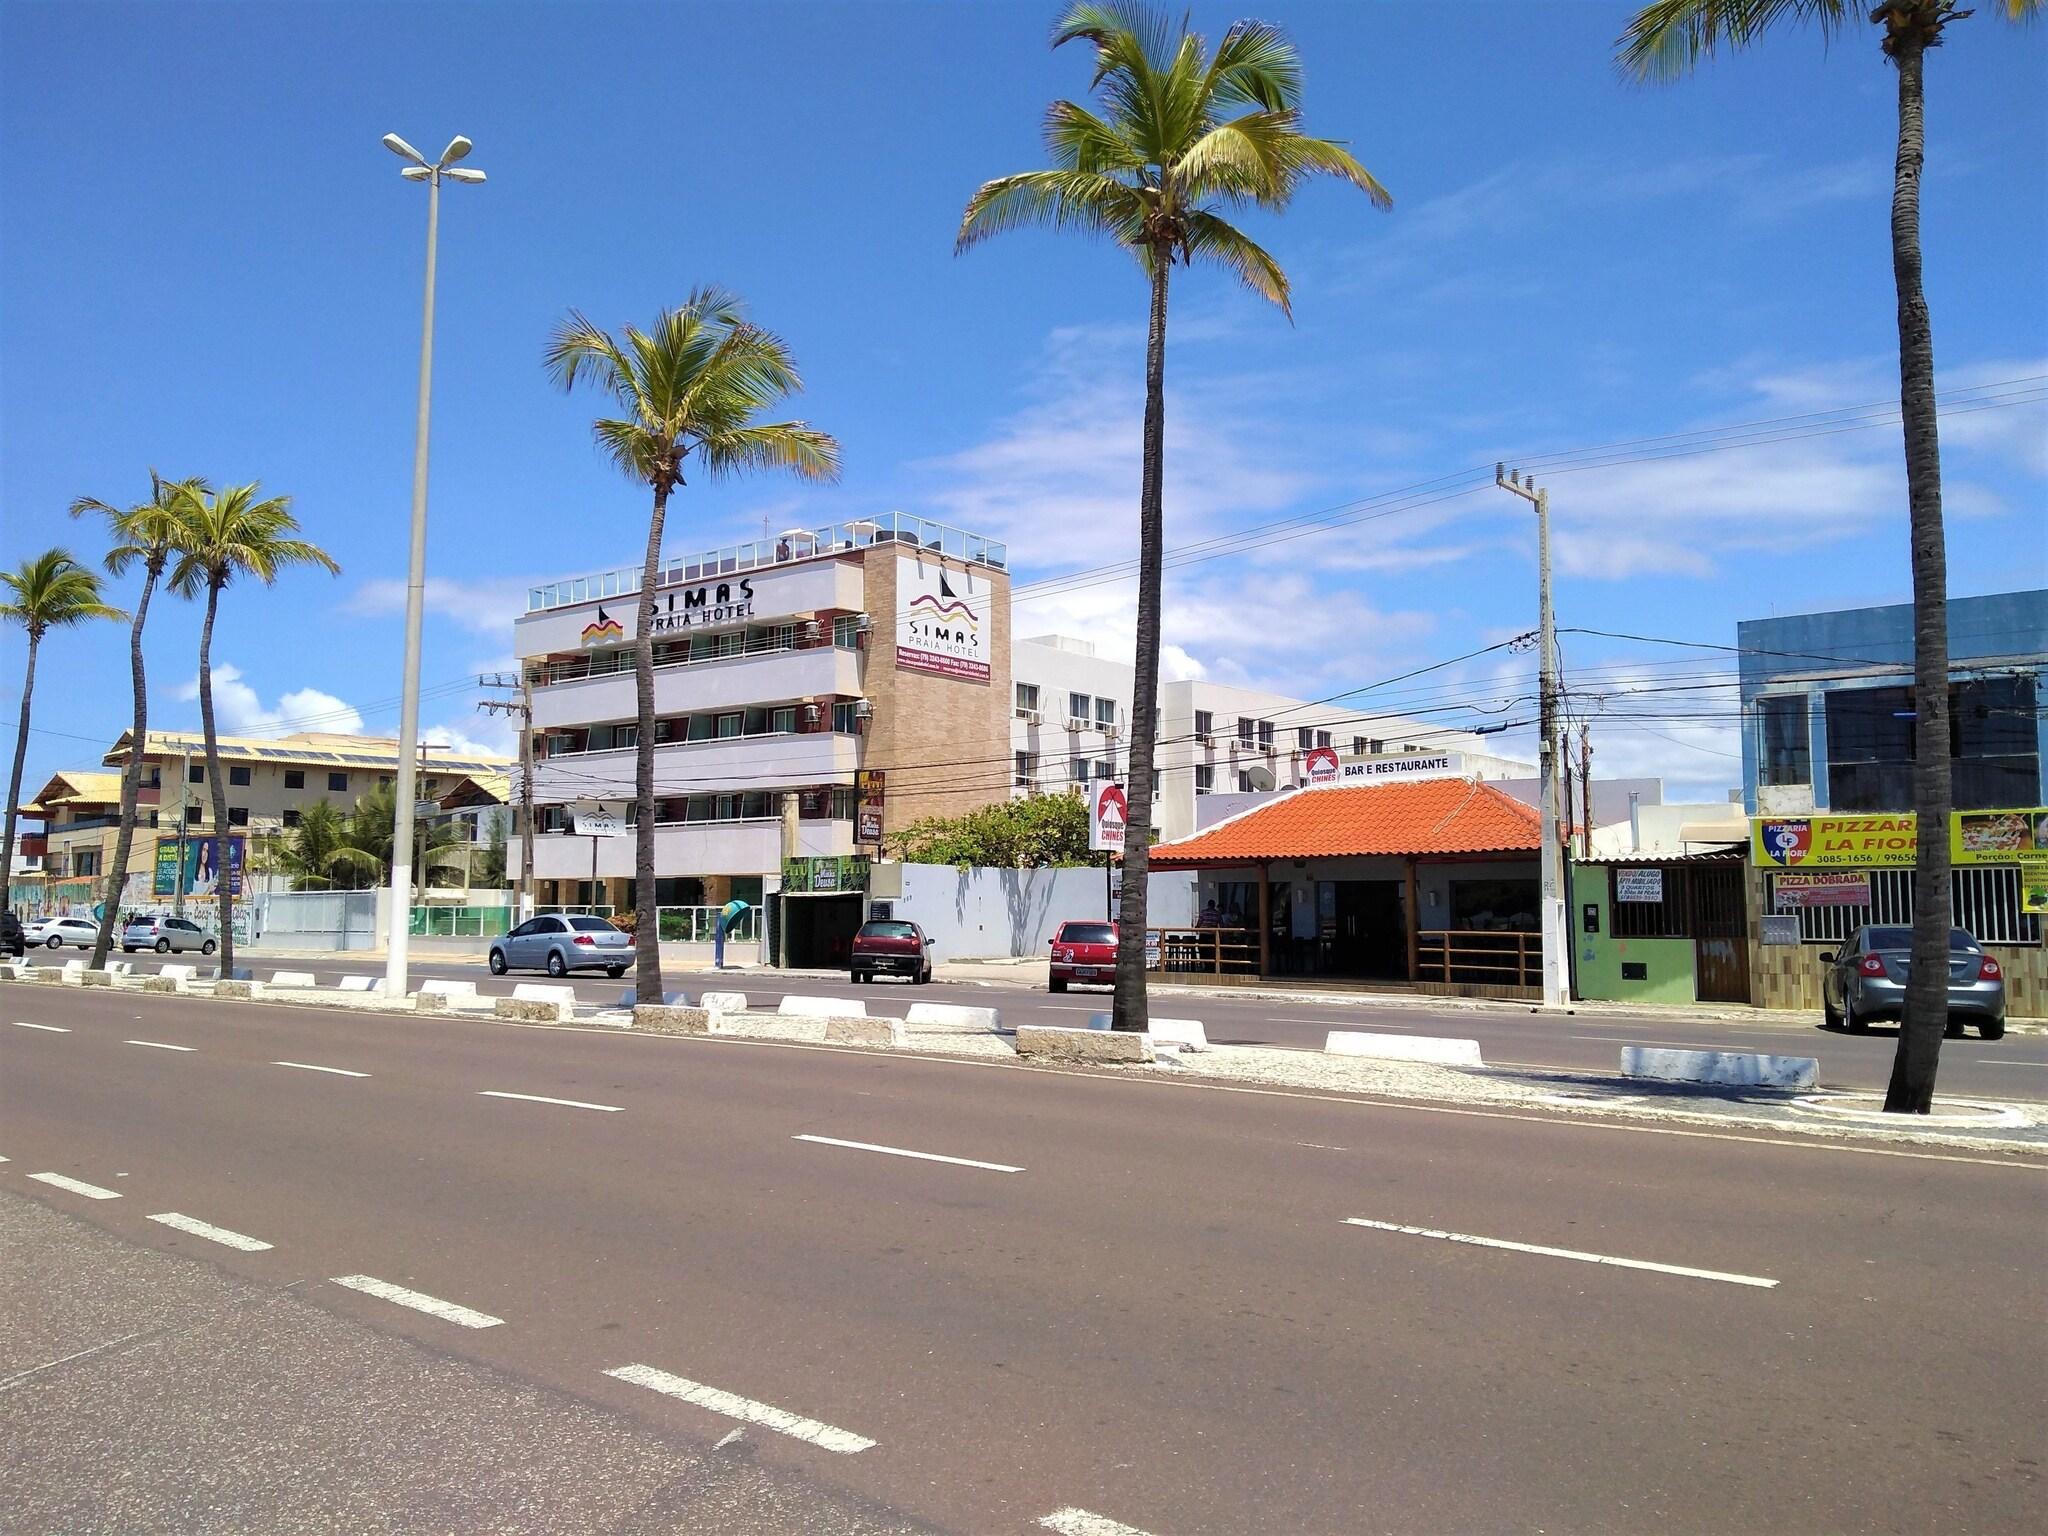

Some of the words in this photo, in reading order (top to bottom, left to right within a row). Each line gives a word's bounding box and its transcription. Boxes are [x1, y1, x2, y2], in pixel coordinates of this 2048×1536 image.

[651, 614, 691, 630] RAIA
[703, 602, 755, 622] HOTEL
[909, 620, 978, 647] SIMAS
[908, 636, 940, 650] PRAIA
[946, 644, 979, 658] HOTEL
[1344, 764, 1364, 776] BAR
[1366, 764, 1373, 775] E
[1375, 758, 1449, 775] RESTAURANTE
[1768, 825, 1808, 833] PIZZARIA
[1820, 819, 1918, 833] PIZZAR
[1824, 838, 1855, 851] LA
[1782, 849, 1808, 857] FIORE
[1816, 854, 1873, 863] 3085-1656
[1779, 876, 1811, 886] PIZZA
[1813, 874, 1865, 885] DOBRADA
